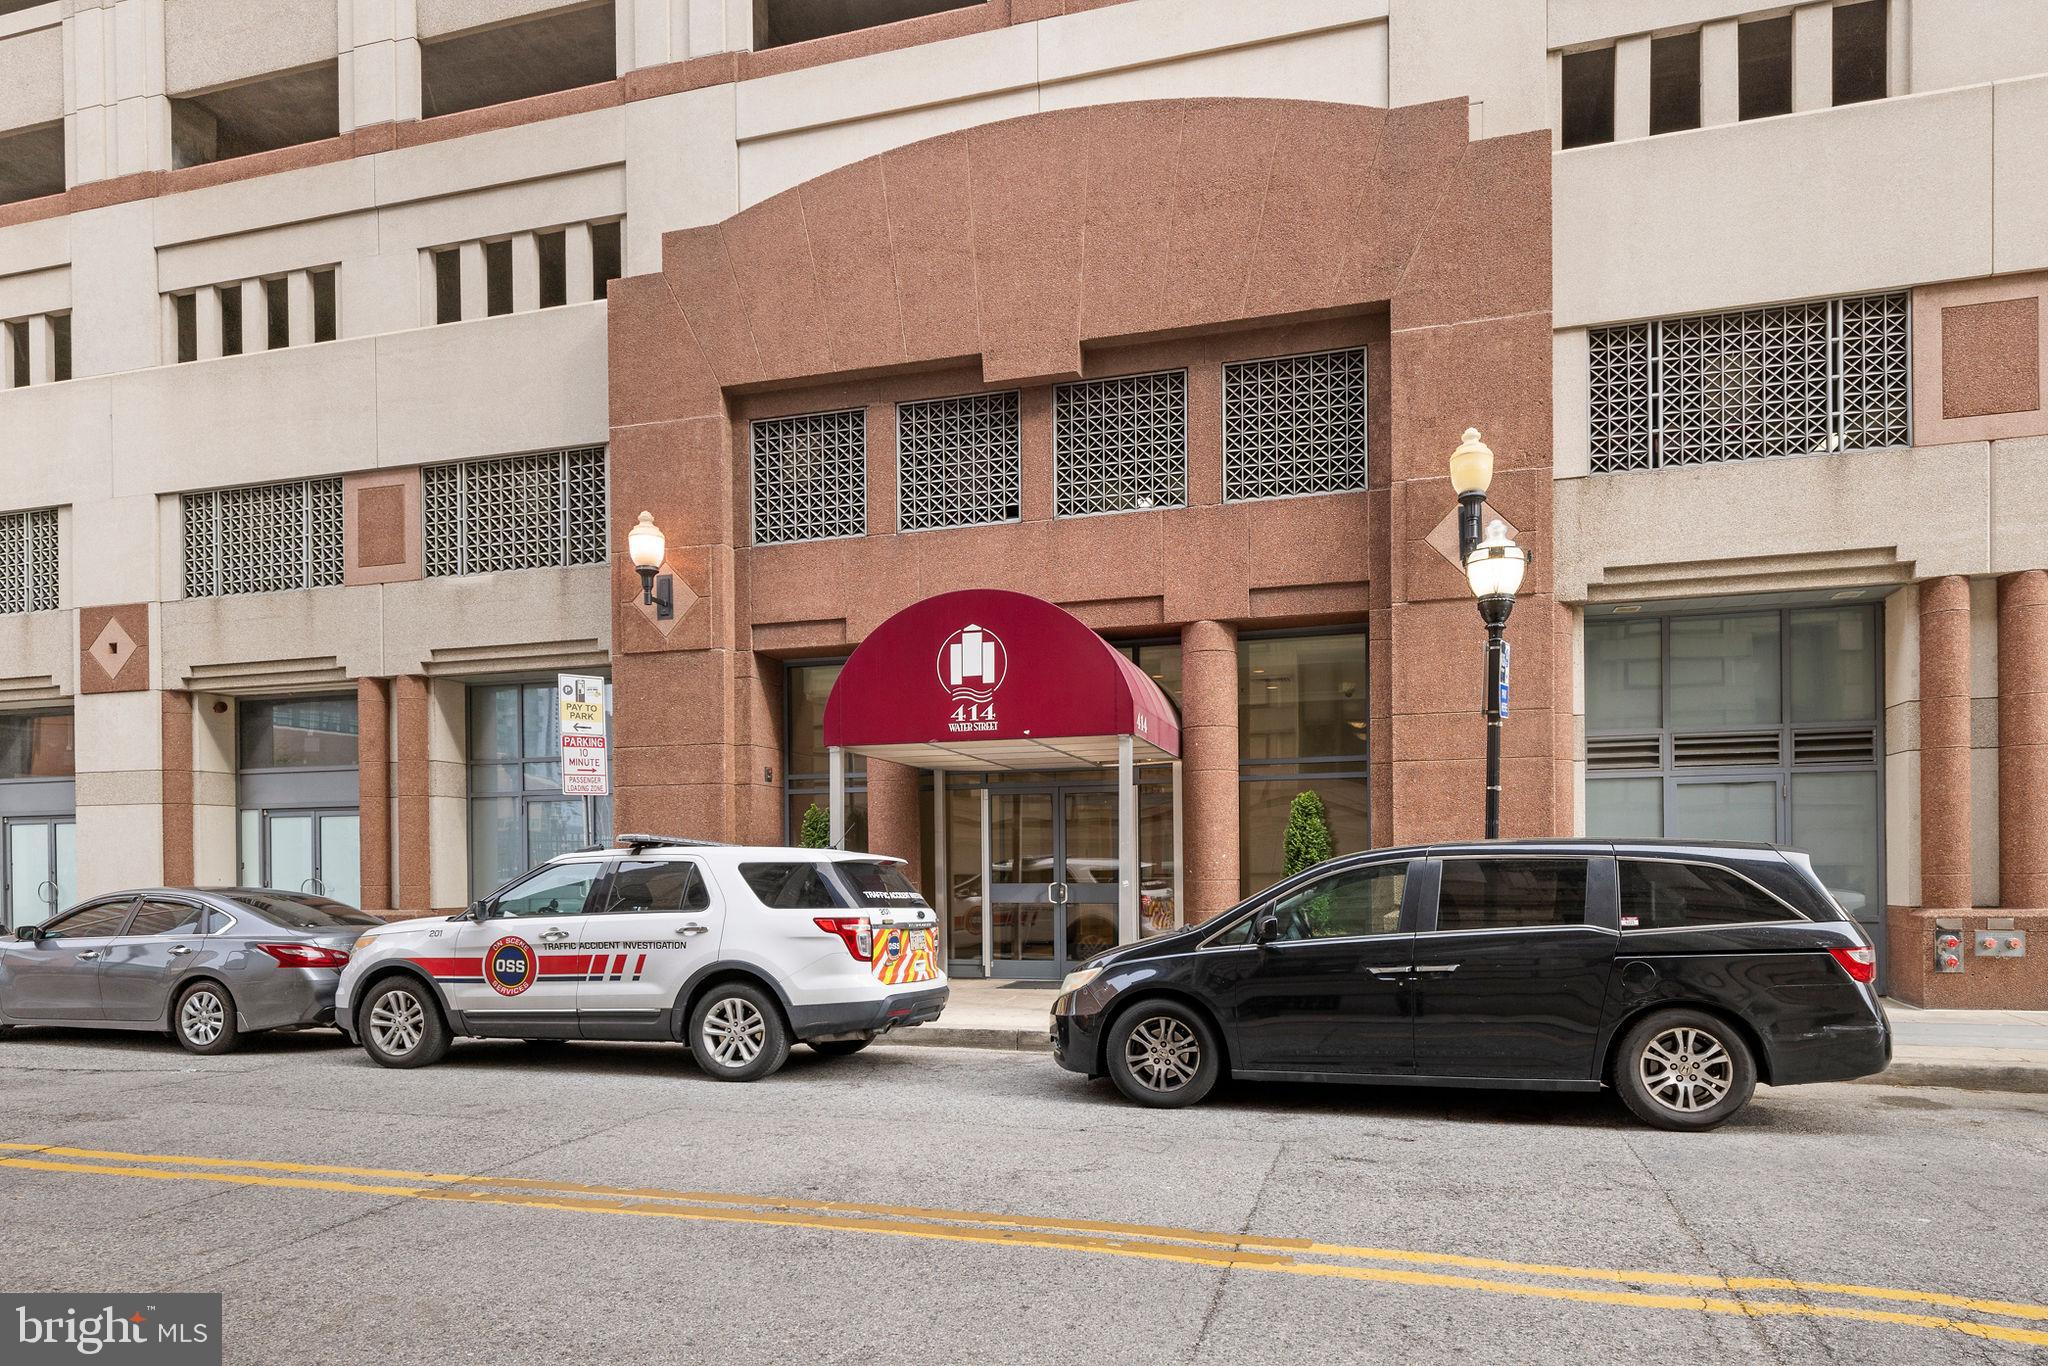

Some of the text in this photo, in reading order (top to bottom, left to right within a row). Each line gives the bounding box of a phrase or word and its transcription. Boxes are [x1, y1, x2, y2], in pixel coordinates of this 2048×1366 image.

[566, 702, 597, 713] PAY TO
[950, 703, 996, 721] 414
[569, 711, 594, 720] PARK
[948, 721, 998, 732] WATER STREET
[1136, 712, 1147, 734] 414
[563, 736, 604, 748] PARKING
[579, 748, 588, 757] 10
[568, 758, 600, 767] MINUTE
[568, 776, 601, 784] PASSENGER
[567, 784, 604, 792] LOADING ZONE
[863, 891, 890, 899] TRAFFIC
[428, 929, 443, 937] 201
[492, 937, 529, 951] ON SCENE
[579, 942, 620, 950] ACCIDENT
[622, 941, 687, 950] INVESTIGATION
[889, 942, 900, 950] OSS
[496, 959, 525, 973] OSS
[492, 980, 529, 995] SERVICES
